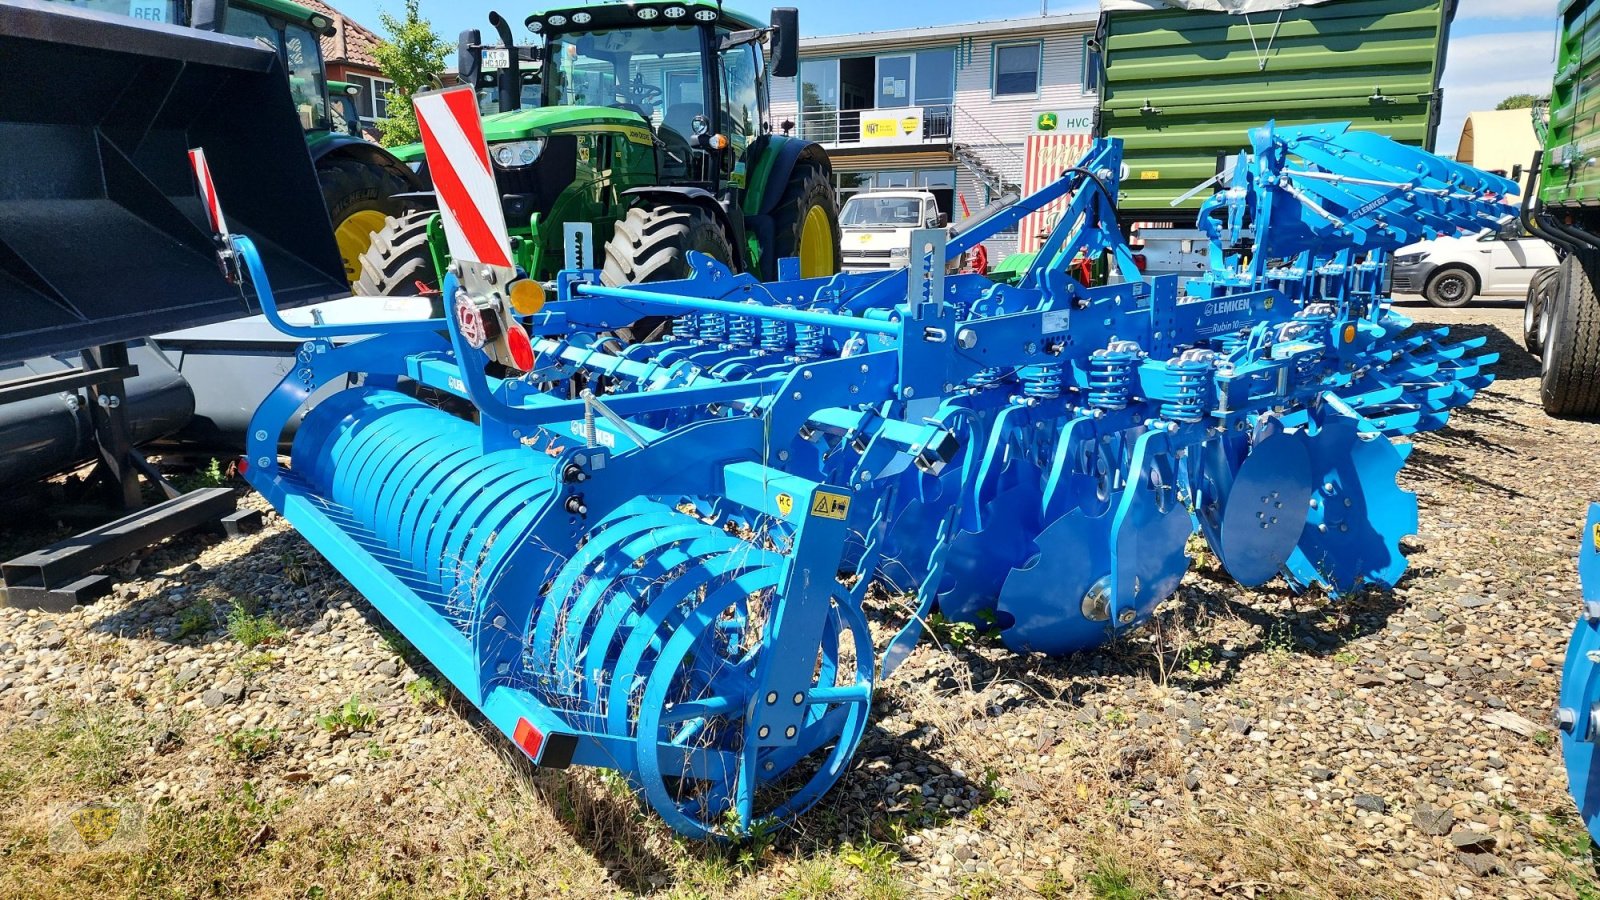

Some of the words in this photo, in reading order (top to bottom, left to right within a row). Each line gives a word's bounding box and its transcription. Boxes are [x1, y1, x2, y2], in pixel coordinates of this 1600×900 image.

[489, 51, 497, 59] KT
[1358, 195, 1389, 216] LEMKEN
[1213, 298, 1250, 315] LEMKEN
[1212, 321, 1232, 333] Rubin
[1231, 319, 1240, 330] 10
